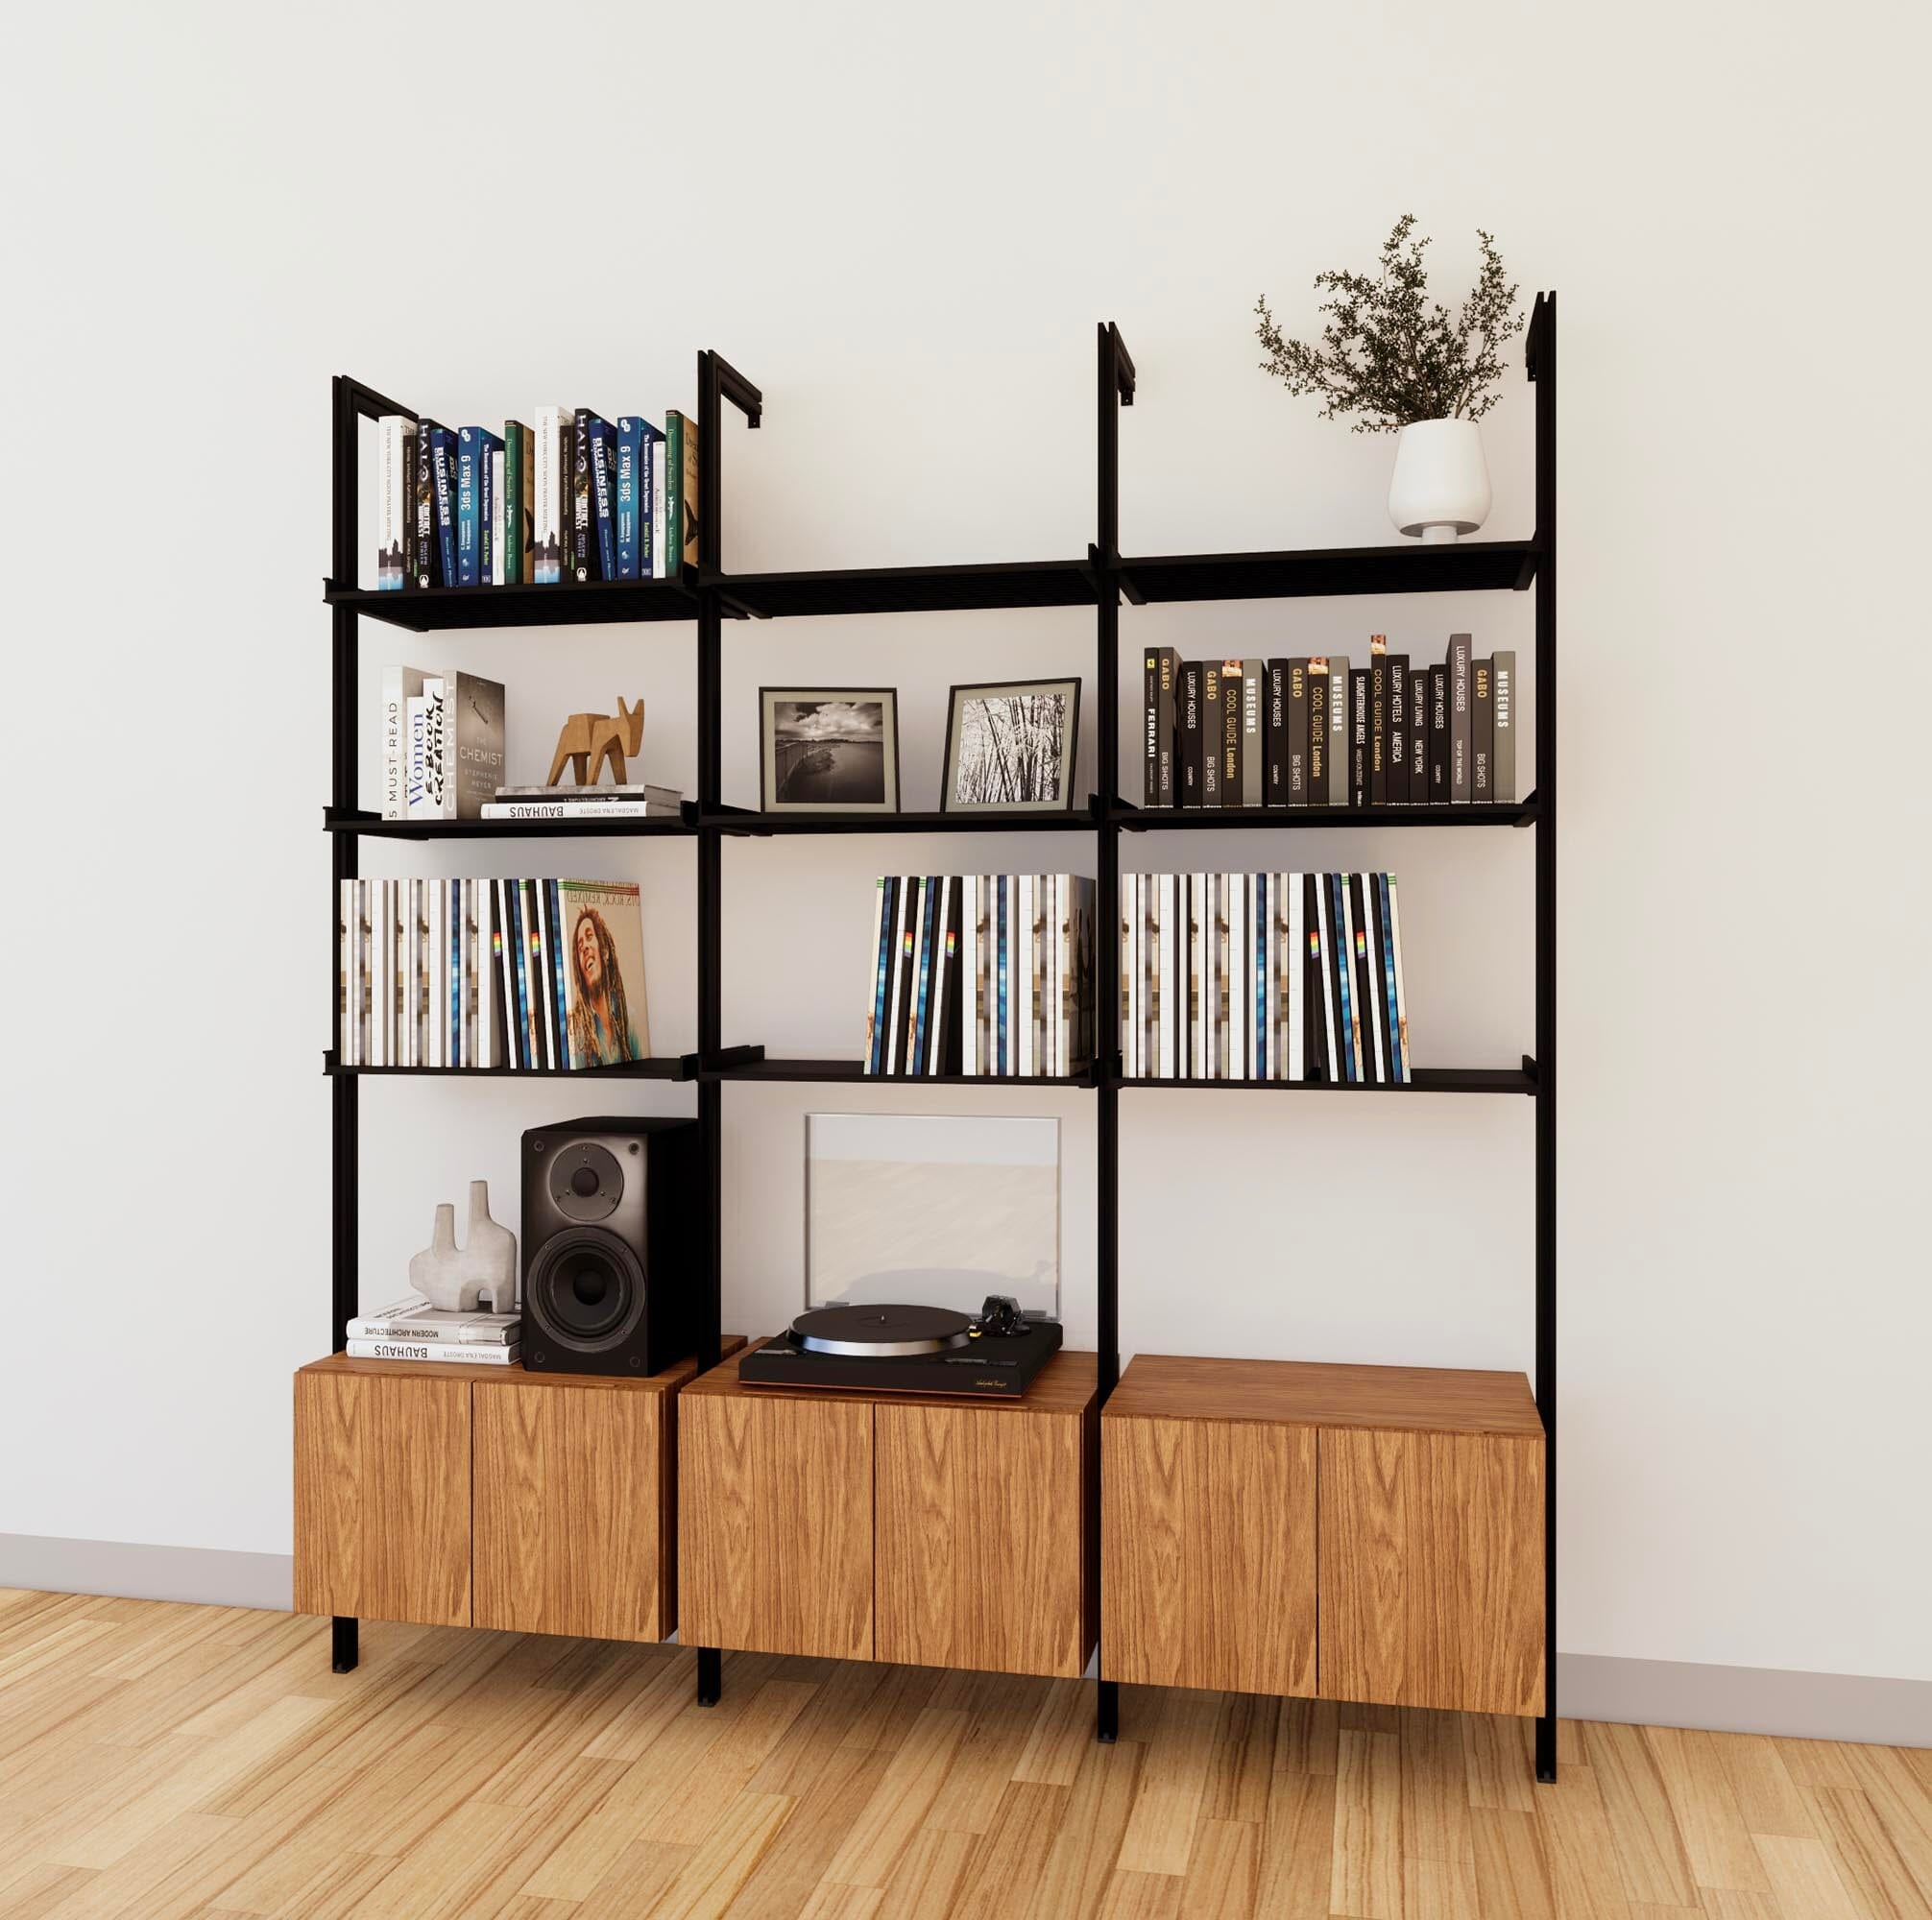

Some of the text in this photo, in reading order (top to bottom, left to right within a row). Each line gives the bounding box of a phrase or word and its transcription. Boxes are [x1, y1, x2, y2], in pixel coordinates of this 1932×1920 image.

[419, 424, 429, 482] HALO
[576, 415, 587, 472] HALO
[620, 455, 631, 479] Max
[437, 446, 450, 526] BUSINESS
[461, 465, 471, 488] Max
[461, 492, 471, 511] 3ds
[592, 438, 605, 518] COMMUNICATIONS
[596, 438, 610, 518] BUSINESS
[620, 482, 631, 502] 3ds
[1207, 671, 1217, 699] GABO
[1246, 678, 1256, 733] MUSEUMS
[1292, 668, 1302, 697] GABO
[1333, 676, 1342, 732] MUSEUMS
[1457, 646, 1465, 711] LUXURY HOUSES
[1478, 670, 1486, 698] GABO
[1498, 671, 1509, 728] MUSEUMS
[1227, 689, 1236, 779] COOL GUIDE London
[1313, 687, 1322, 777] COOL GUIDE London
[1356, 677, 1365, 744] SLAUGHTERHOUSE ANGELS
[1392, 665, 1402, 763] LUXURY HOTELS AMERICA
[409, 714, 423, 806] Women
[425, 703, 434, 794] E-BOOK
[432, 691, 444, 805] CREATION
[446, 681, 455, 811] CHEMIST
[459, 746, 502, 766] CHEMIST
[1477, 754, 1485, 787] BIG SHOTS
[510, 806, 564, 817] BAUHAUS
[365, 1328, 410, 1337] ARCHITECTURE
[374, 1344, 427, 1357] BAUHAUS
